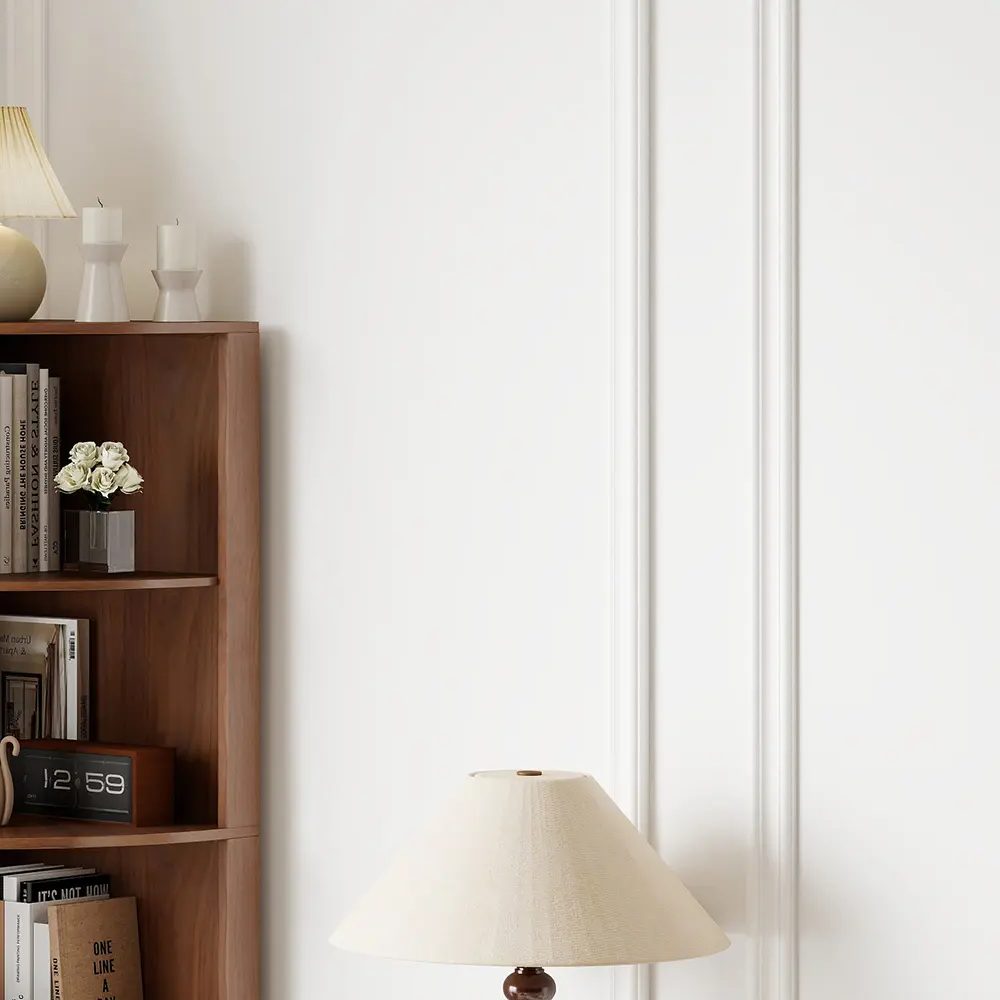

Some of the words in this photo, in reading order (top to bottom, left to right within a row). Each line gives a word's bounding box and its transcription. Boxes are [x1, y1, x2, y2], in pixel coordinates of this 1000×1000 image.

[93, 940, 112, 956] ONE
[93, 958, 115, 975] LINE
[102, 978, 109, 993] A
